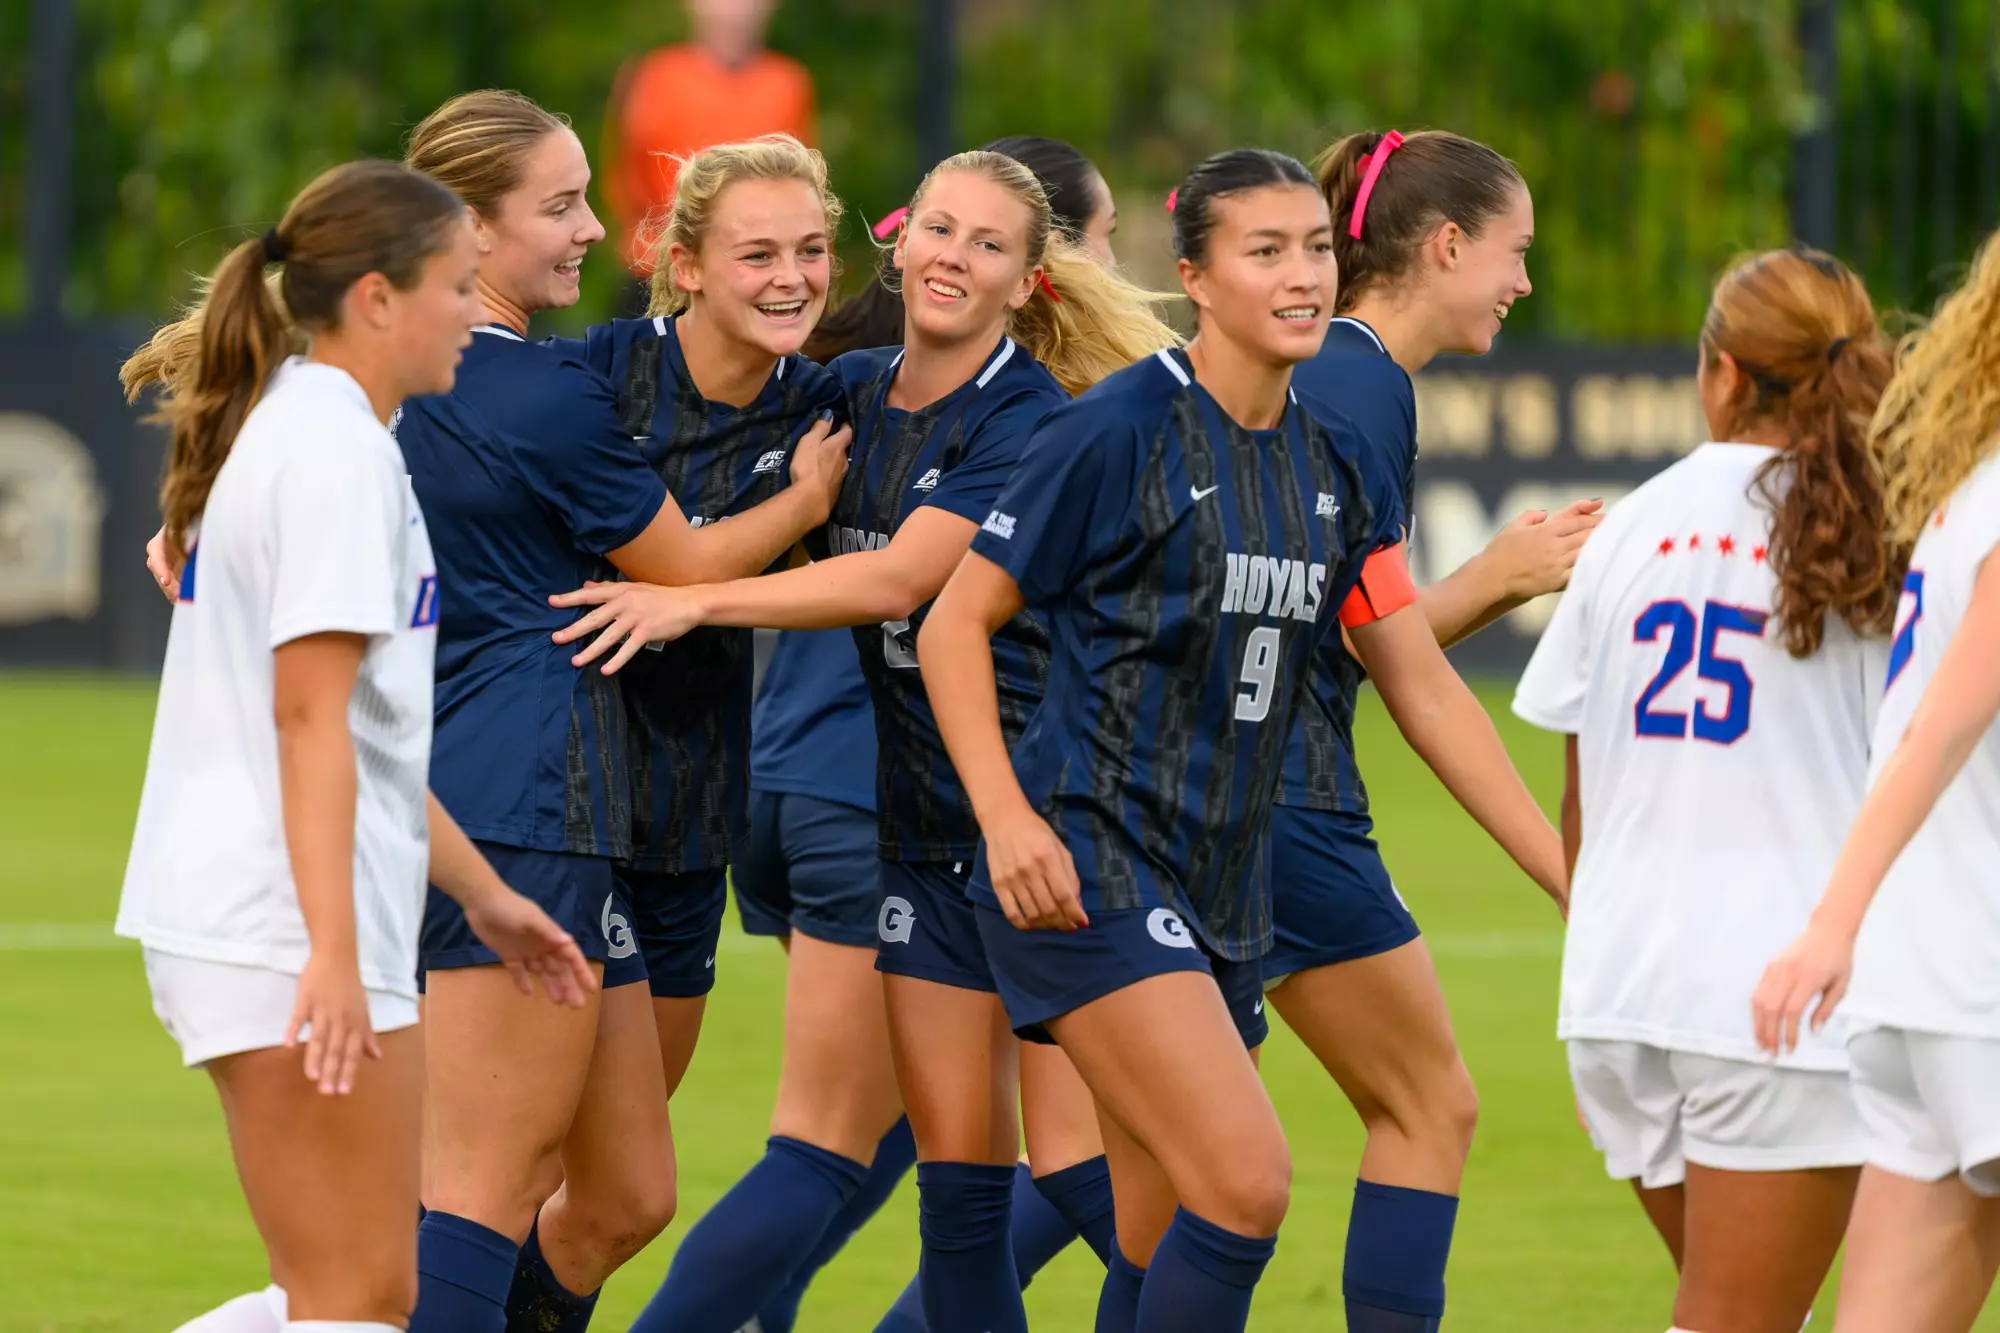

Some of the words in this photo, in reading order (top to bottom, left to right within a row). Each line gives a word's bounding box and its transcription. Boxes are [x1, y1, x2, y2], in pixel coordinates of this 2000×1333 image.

[760, 450, 786, 460] BIG
[924, 468, 941, 478] BI
[1220, 553, 1326, 623] HOYAS
[1234, 626, 1281, 722] 9
[1633, 598, 1770, 746] 25
[878, 895, 917, 945] G
[1146, 906, 1197, 950] G
